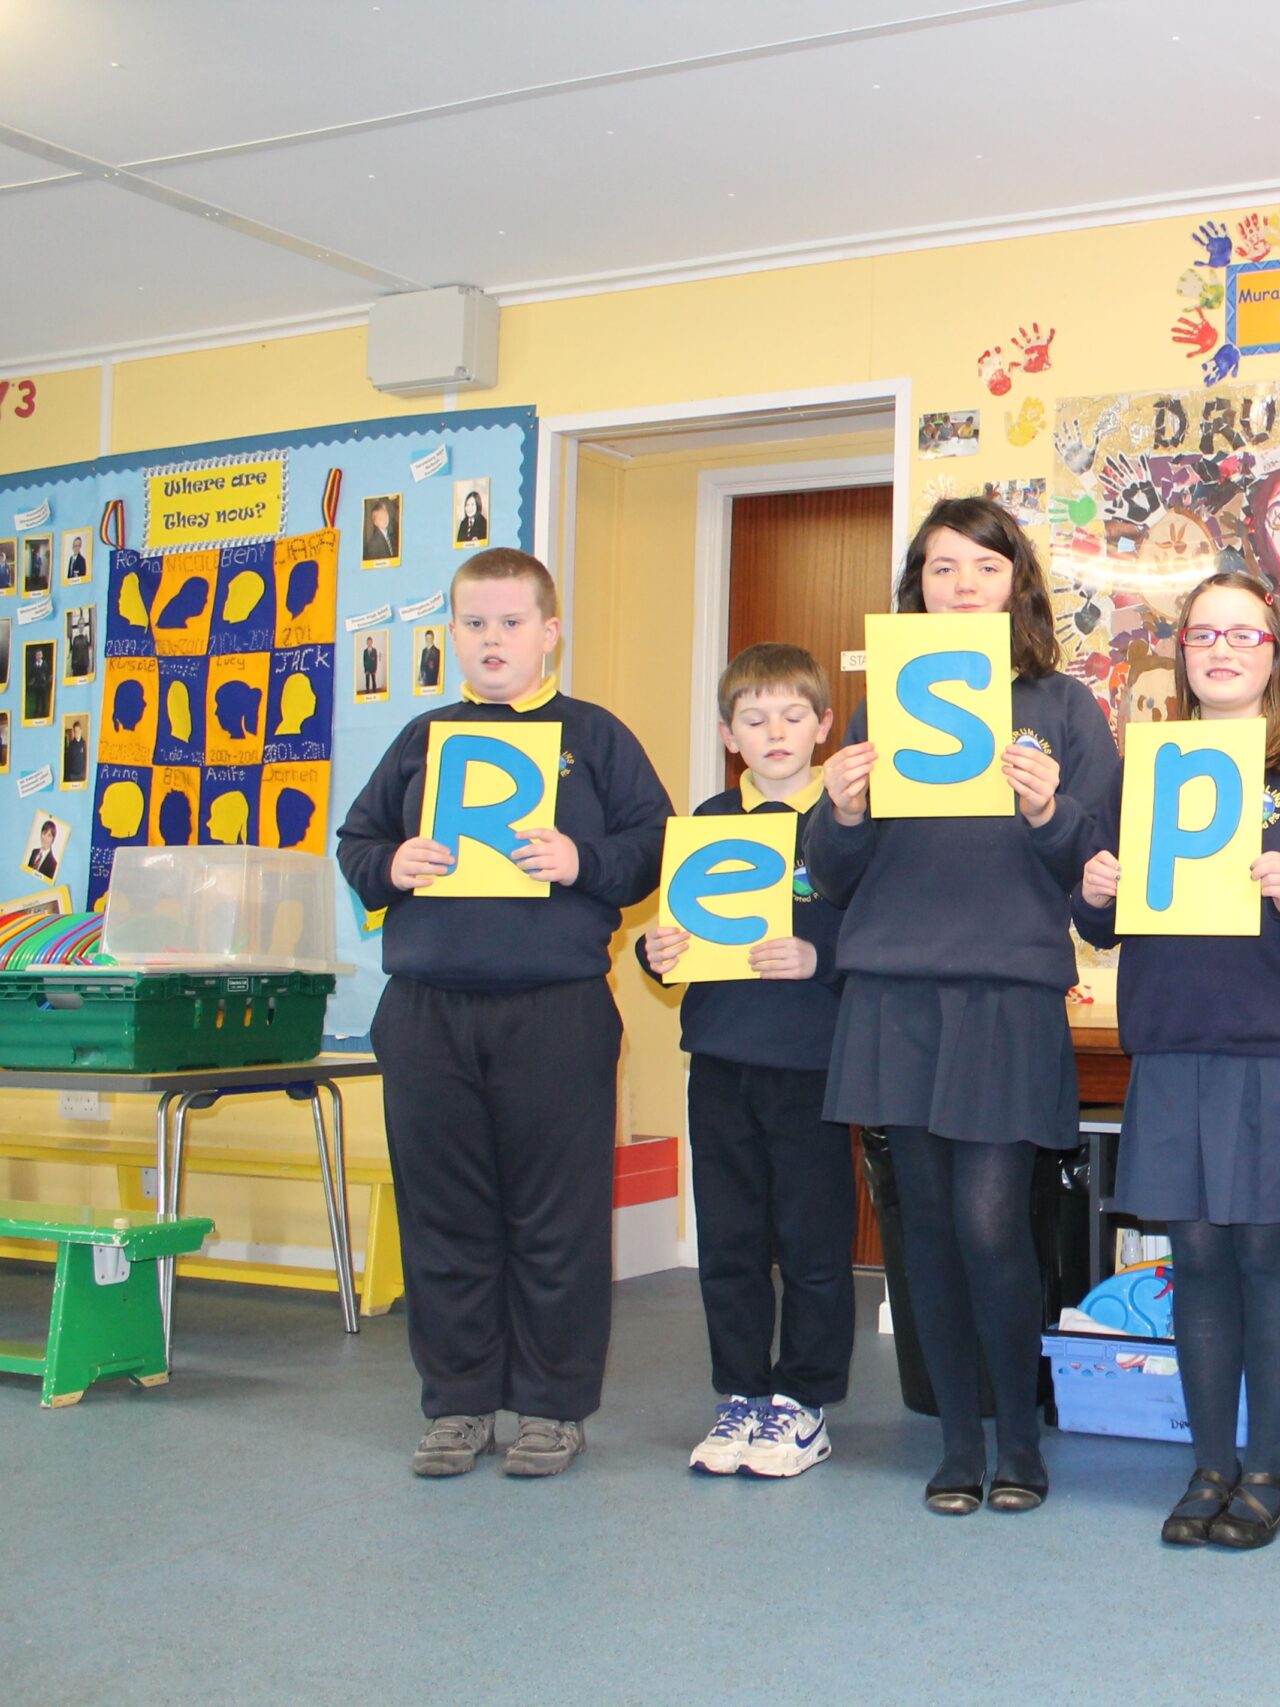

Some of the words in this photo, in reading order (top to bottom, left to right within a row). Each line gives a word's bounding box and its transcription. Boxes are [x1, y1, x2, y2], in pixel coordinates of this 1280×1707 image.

[164, 477, 226, 497] Where
[231, 471, 267, 488] are
[163, 511, 211, 530] They
[215, 502, 267, 523] now?
[849, 655, 867, 667] STA
[433, 734, 545, 877] R
[667, 838, 787, 946] e
[1146, 742, 1243, 912] p
